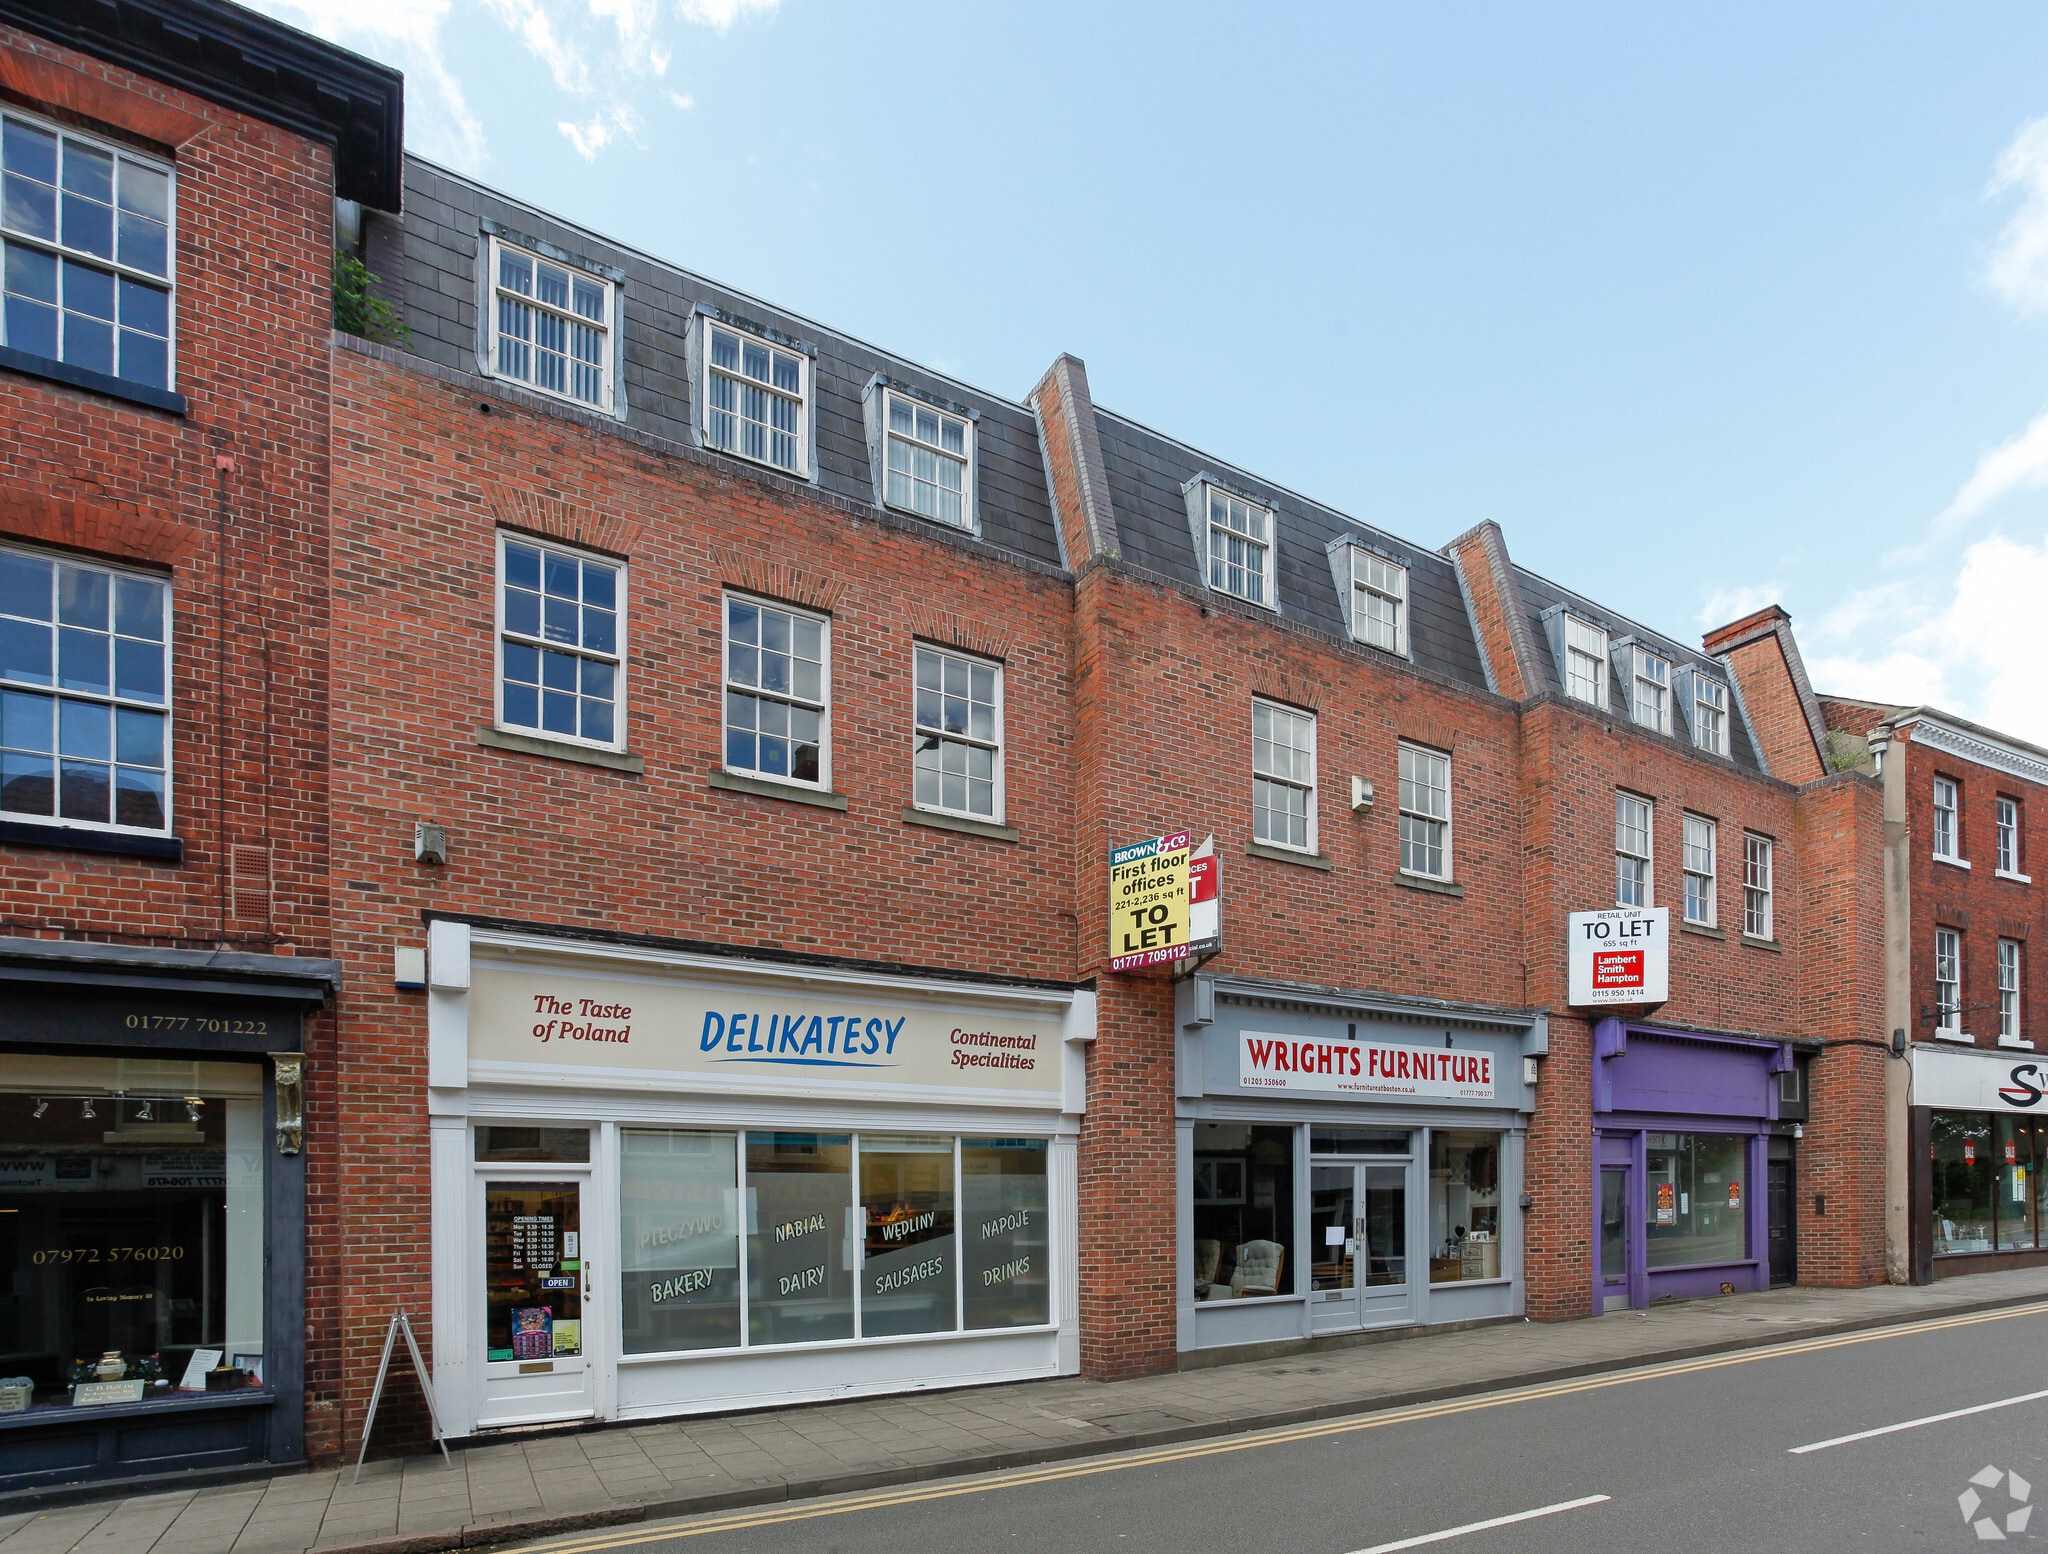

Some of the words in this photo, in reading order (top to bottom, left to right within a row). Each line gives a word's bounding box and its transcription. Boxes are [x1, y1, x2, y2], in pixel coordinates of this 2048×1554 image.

[1112, 862, 1146, 882] First
[1151, 853, 1187, 873] floor
[1123, 874, 1175, 896] offices
[1115, 893, 1159, 911] 221-2,236
[1162, 891, 1174, 900] sq
[1176, 887, 1184, 896] ft
[1130, 904, 1169, 929] TO
[1624, 911, 1642, 919] UNIT
[1124, 923, 1178, 953] LET
[1582, 922, 1610, 940] TO
[1620, 919, 1655, 938] LET
[1603, 940, 1616, 948] 655
[1113, 954, 1143, 970] 01777
[1148, 945, 1187, 964] 709112
[1598, 955, 1636, 965] Lambert
[1597, 974, 1639, 984] Hampton
[1598, 965, 1625, 974] Smith
[1611, 989, 1625, 997] 950
[534, 994, 572, 1015] The
[579, 998, 632, 1021] Taste
[126, 1014, 189, 1031] 01777
[196, 1018, 267, 1035] 701222
[532, 1020, 558, 1043] of
[558, 1022, 632, 1043] Poland
[700, 1010, 906, 1055] DELIKATESY
[950, 1028, 1037, 1050] Continental
[951, 1049, 1036, 1070] Specialities
[1246, 1038, 1361, 1076] WRIGHTS
[1368, 1048, 1490, 1084] FURNITURE
[1243, 1077, 1263, 1085] 01205
[1264, 1079, 1287, 1087] 350600
[1337, 1082, 1416, 1094] www.furnitureatboston.co.uk
[639, 1214, 723, 1249] PIECZYWO
[774, 1213, 827, 1244] NABIAŁ
[882, 1211, 935, 1241] WĘDLINY
[981, 1209, 1031, 1240] NAPOJE
[32, 1249, 100, 1265] 07972
[107, 1246, 184, 1262] 576020
[548, 1279, 569, 1287] OPEN
[778, 1265, 825, 1296] DAIRY
[875, 1256, 944, 1295] SAUSAGES
[982, 1256, 1031, 1287] DRINKS
[650, 1266, 714, 1303] BAKERY
